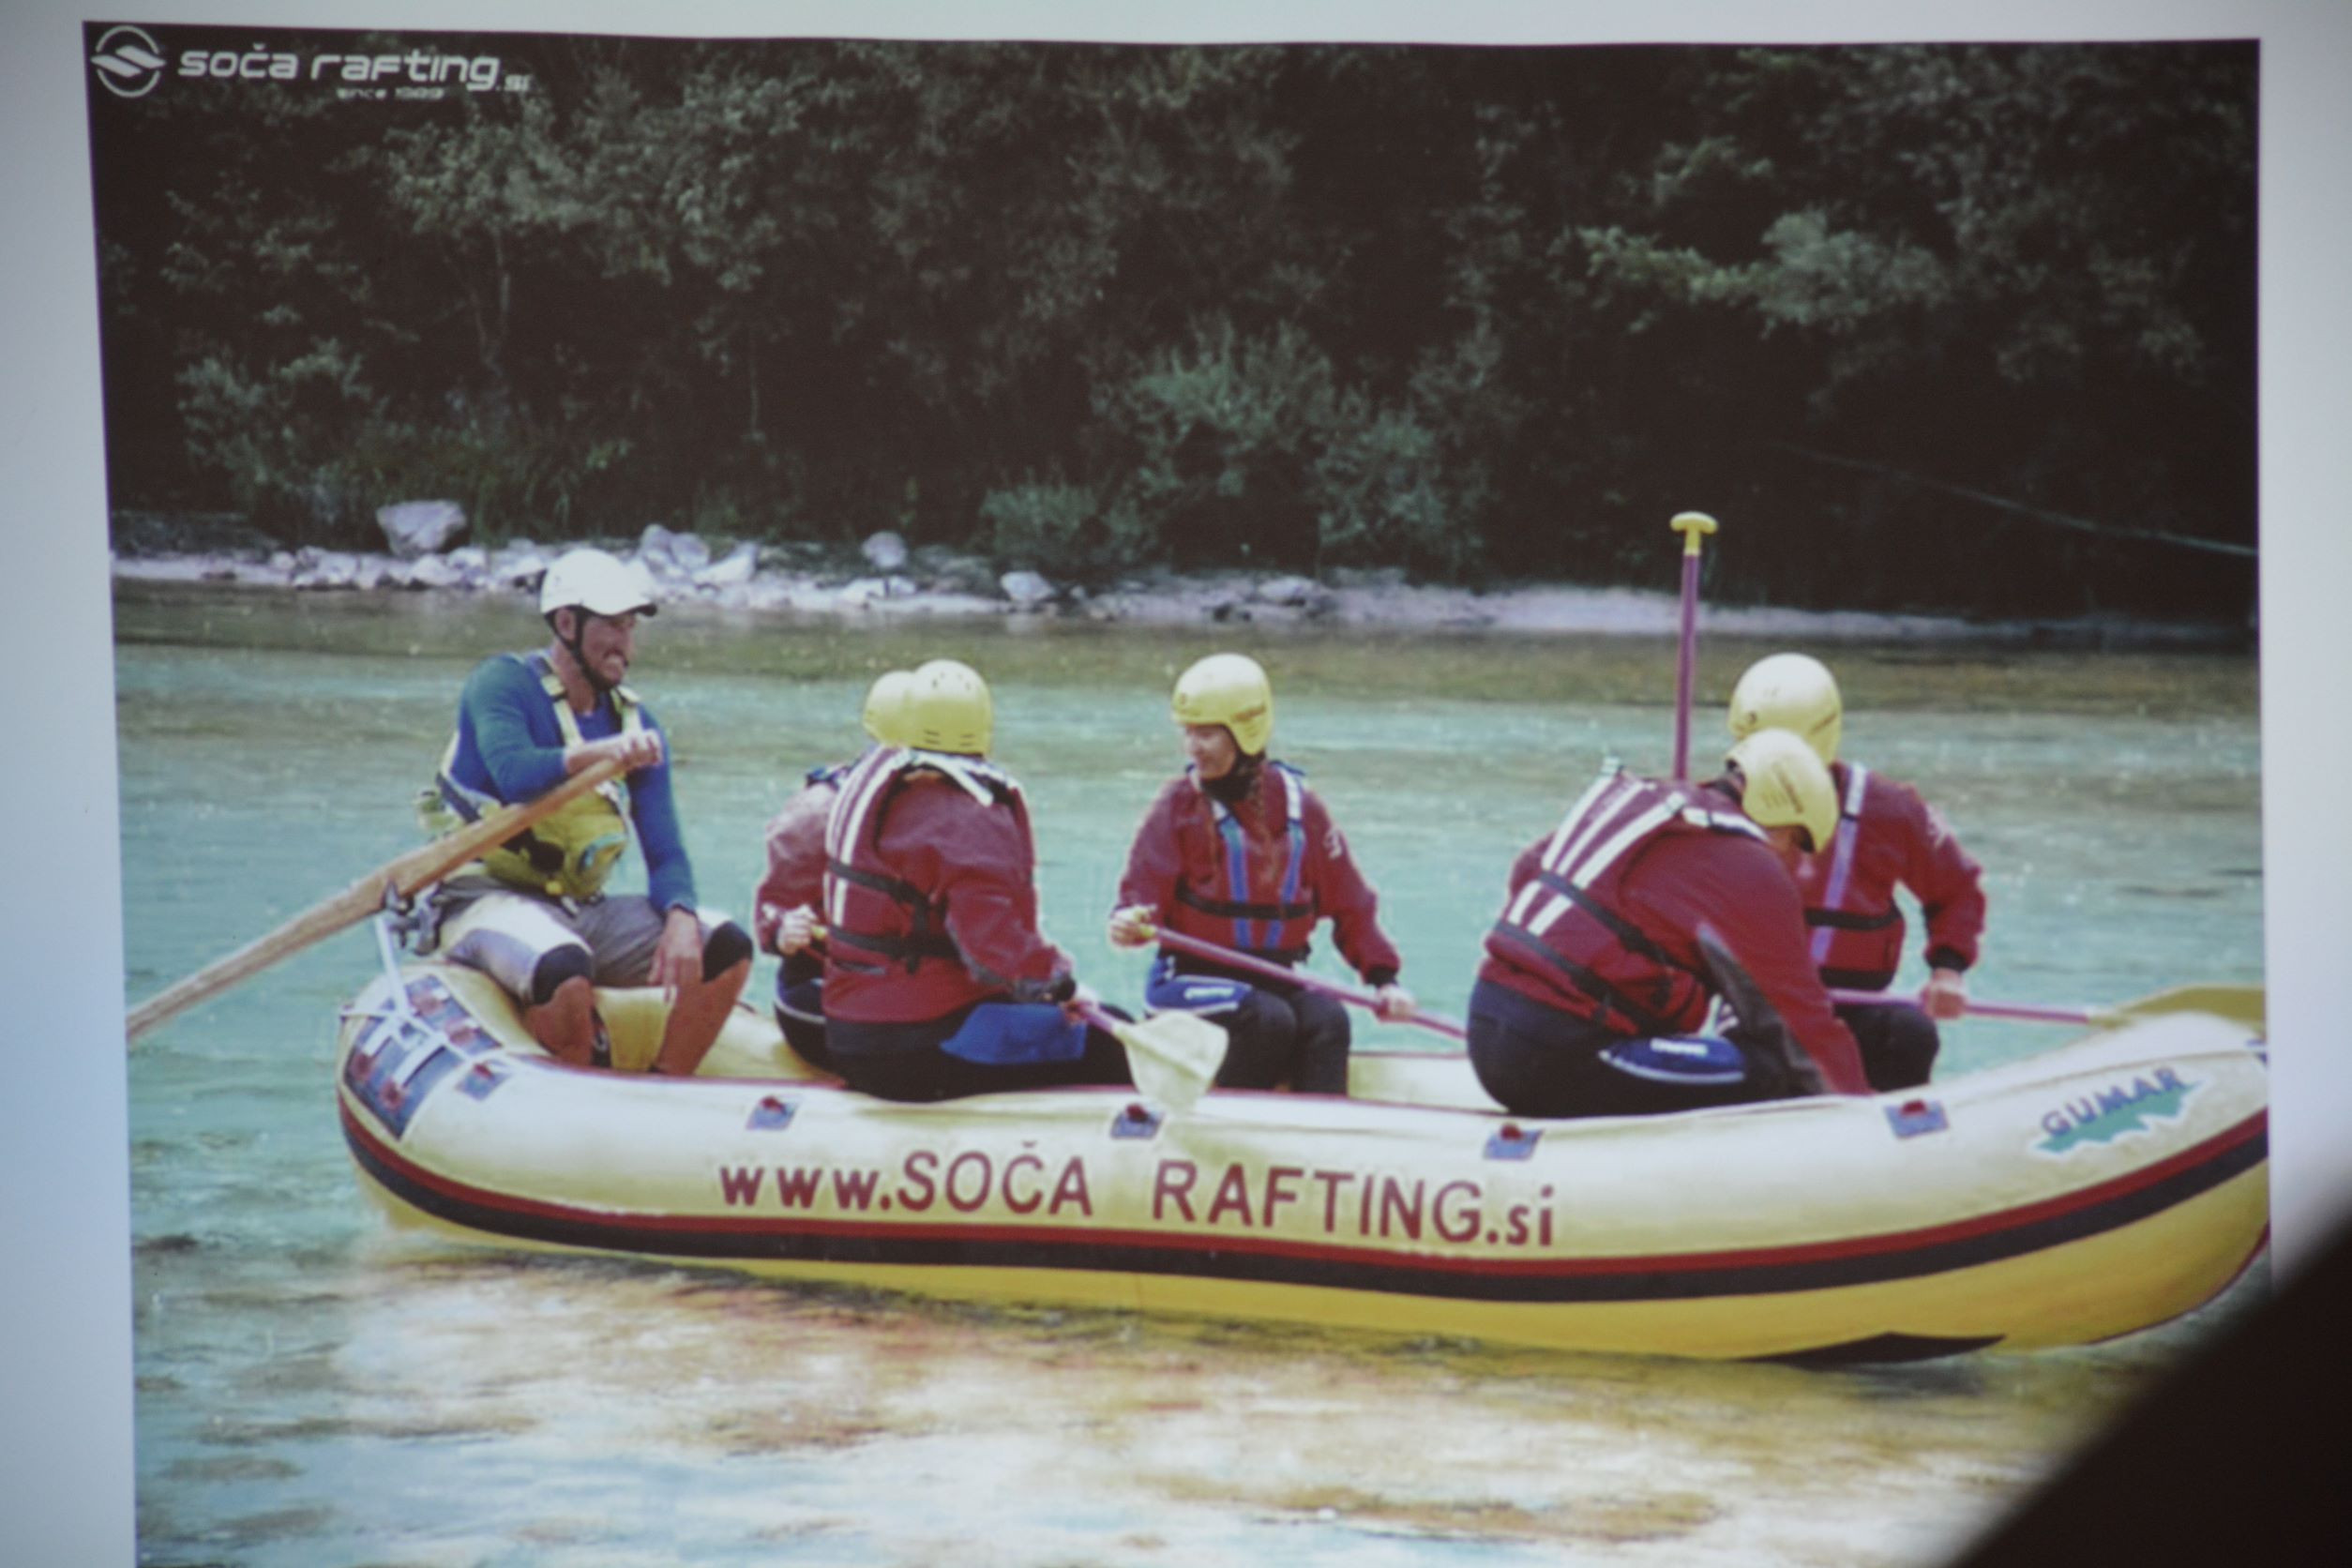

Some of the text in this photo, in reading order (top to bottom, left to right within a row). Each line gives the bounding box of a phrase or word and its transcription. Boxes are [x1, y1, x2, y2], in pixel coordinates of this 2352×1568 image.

[178, 43, 298, 79] soča
[2041, 1065, 2190, 1137] GUMAR
[719, 1140, 1556, 1247] www.SOČA RAFTING.si
